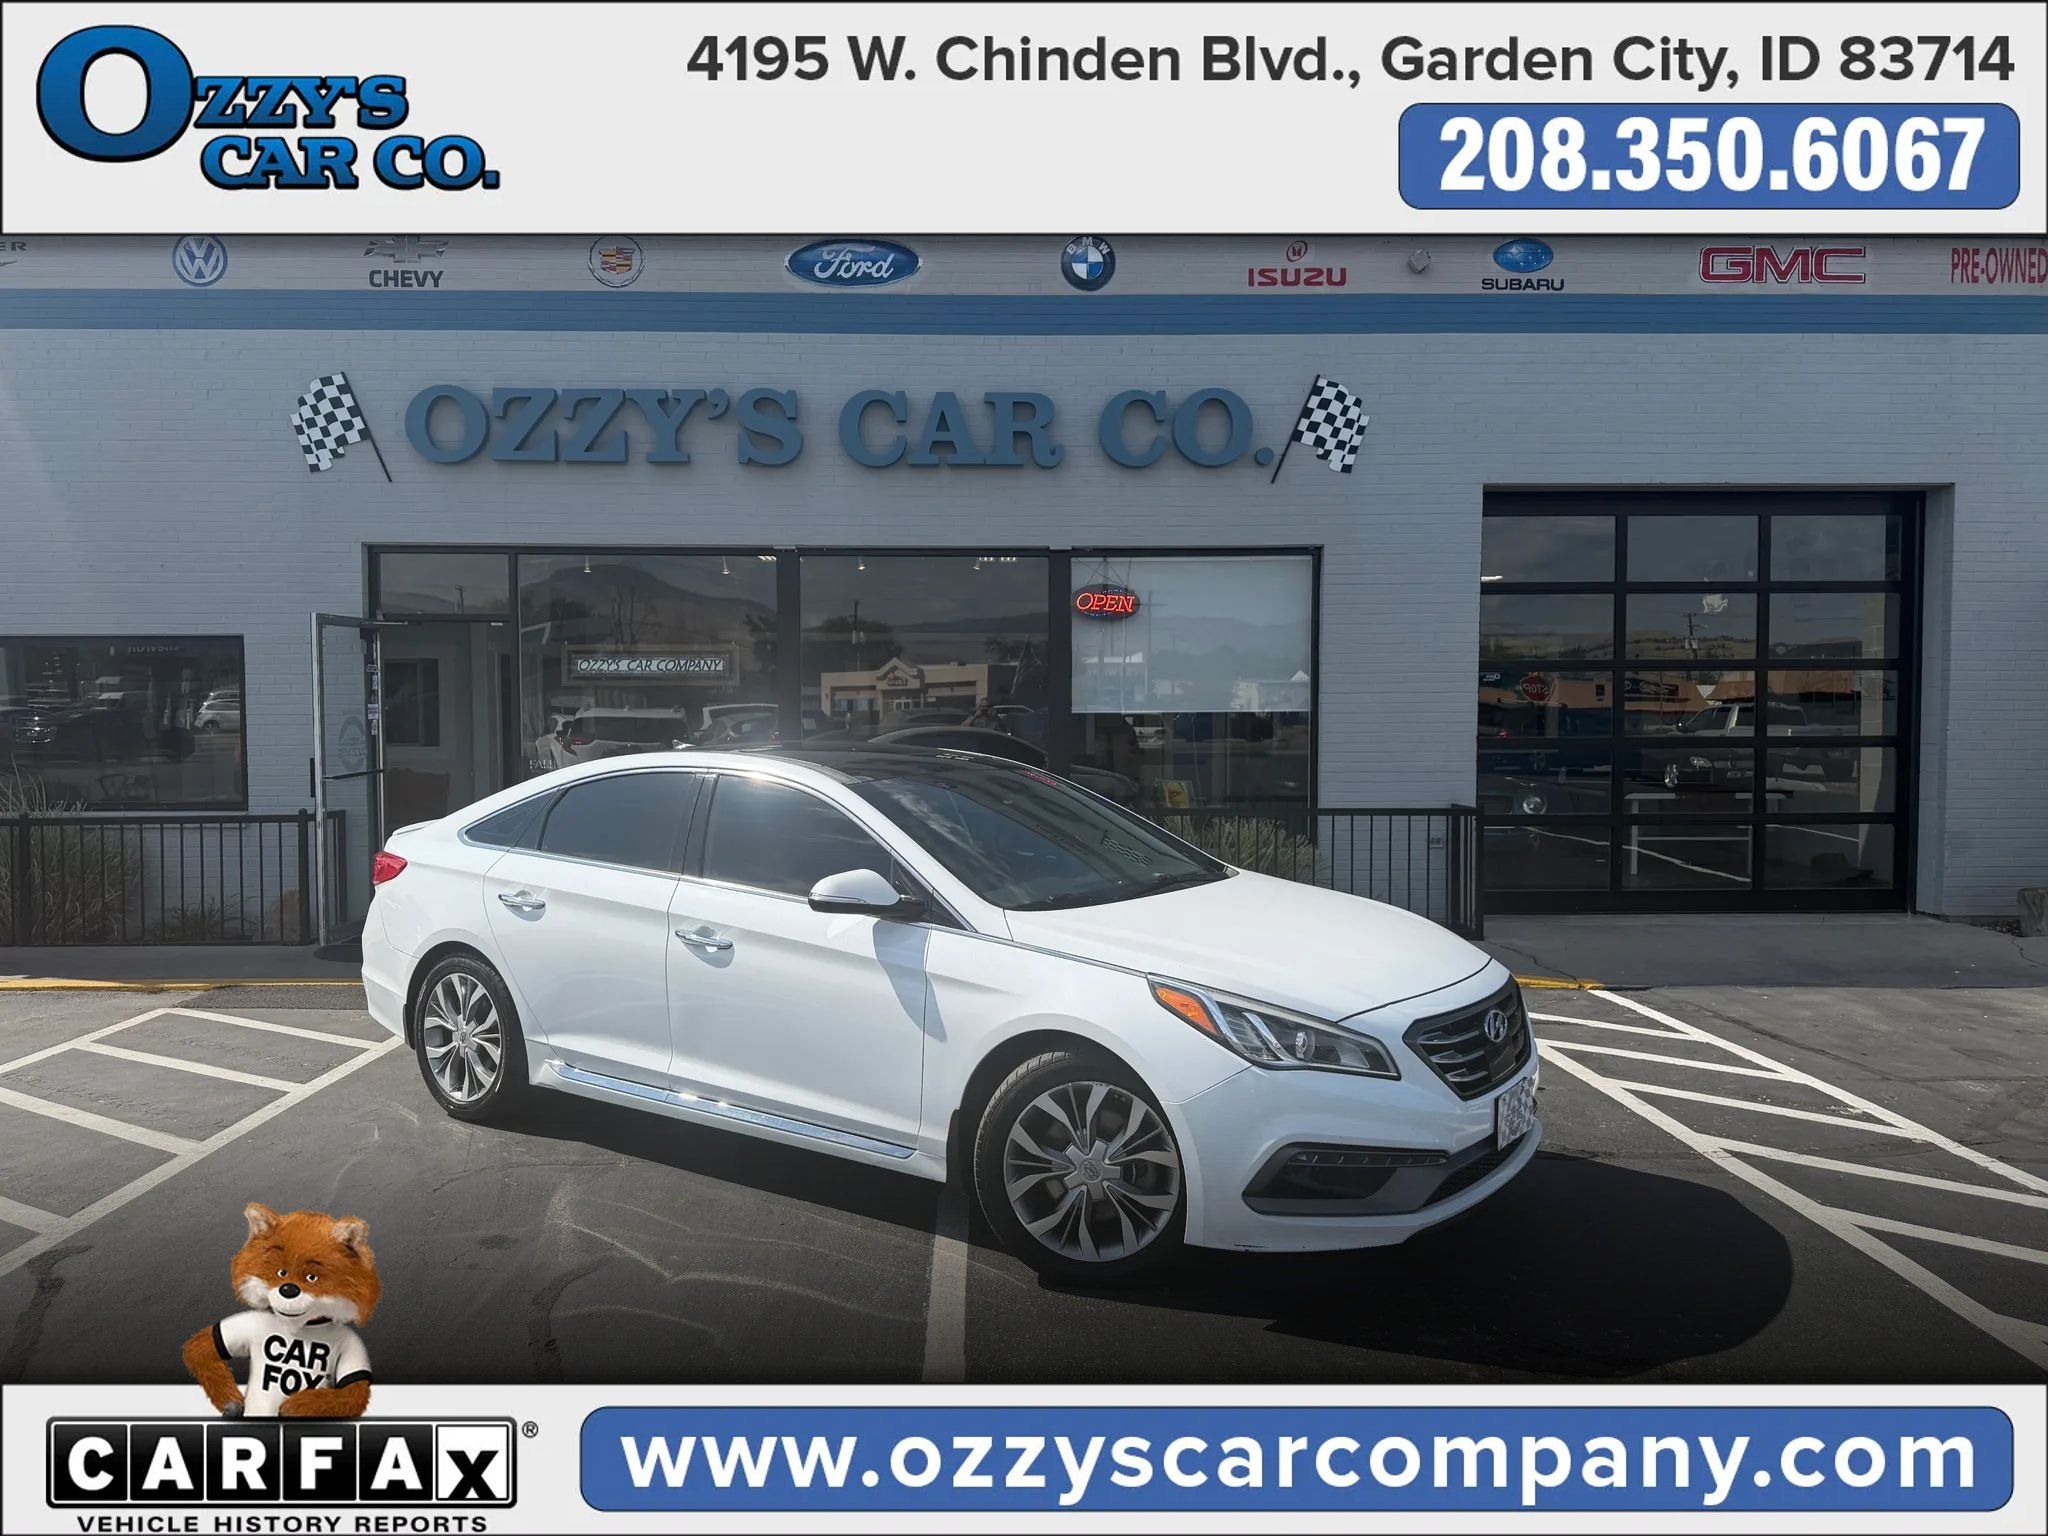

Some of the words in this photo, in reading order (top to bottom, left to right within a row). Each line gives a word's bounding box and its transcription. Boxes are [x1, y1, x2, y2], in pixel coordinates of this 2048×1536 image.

[1066, 237, 1110, 255] BMW
[814, 247, 894, 279] Ford
[1700, 246, 1866, 283] GMC
[1951, 247, 2048, 284] PRE-OWNED
[369, 269, 444, 288] CHEVY
[1248, 267, 1347, 287] ISUZU
[1481, 278, 1565, 291] SUBARU
[405, 384, 802, 467] OZZY'S
[838, 388, 1064, 469] CAR
[1099, 387, 1275, 469] CO.
[1077, 592, 1134, 612] OPEN
[578, 658, 621, 672] OZZY'S
[627, 658, 652, 672] CAR
[656, 658, 722, 672] COMPANY
